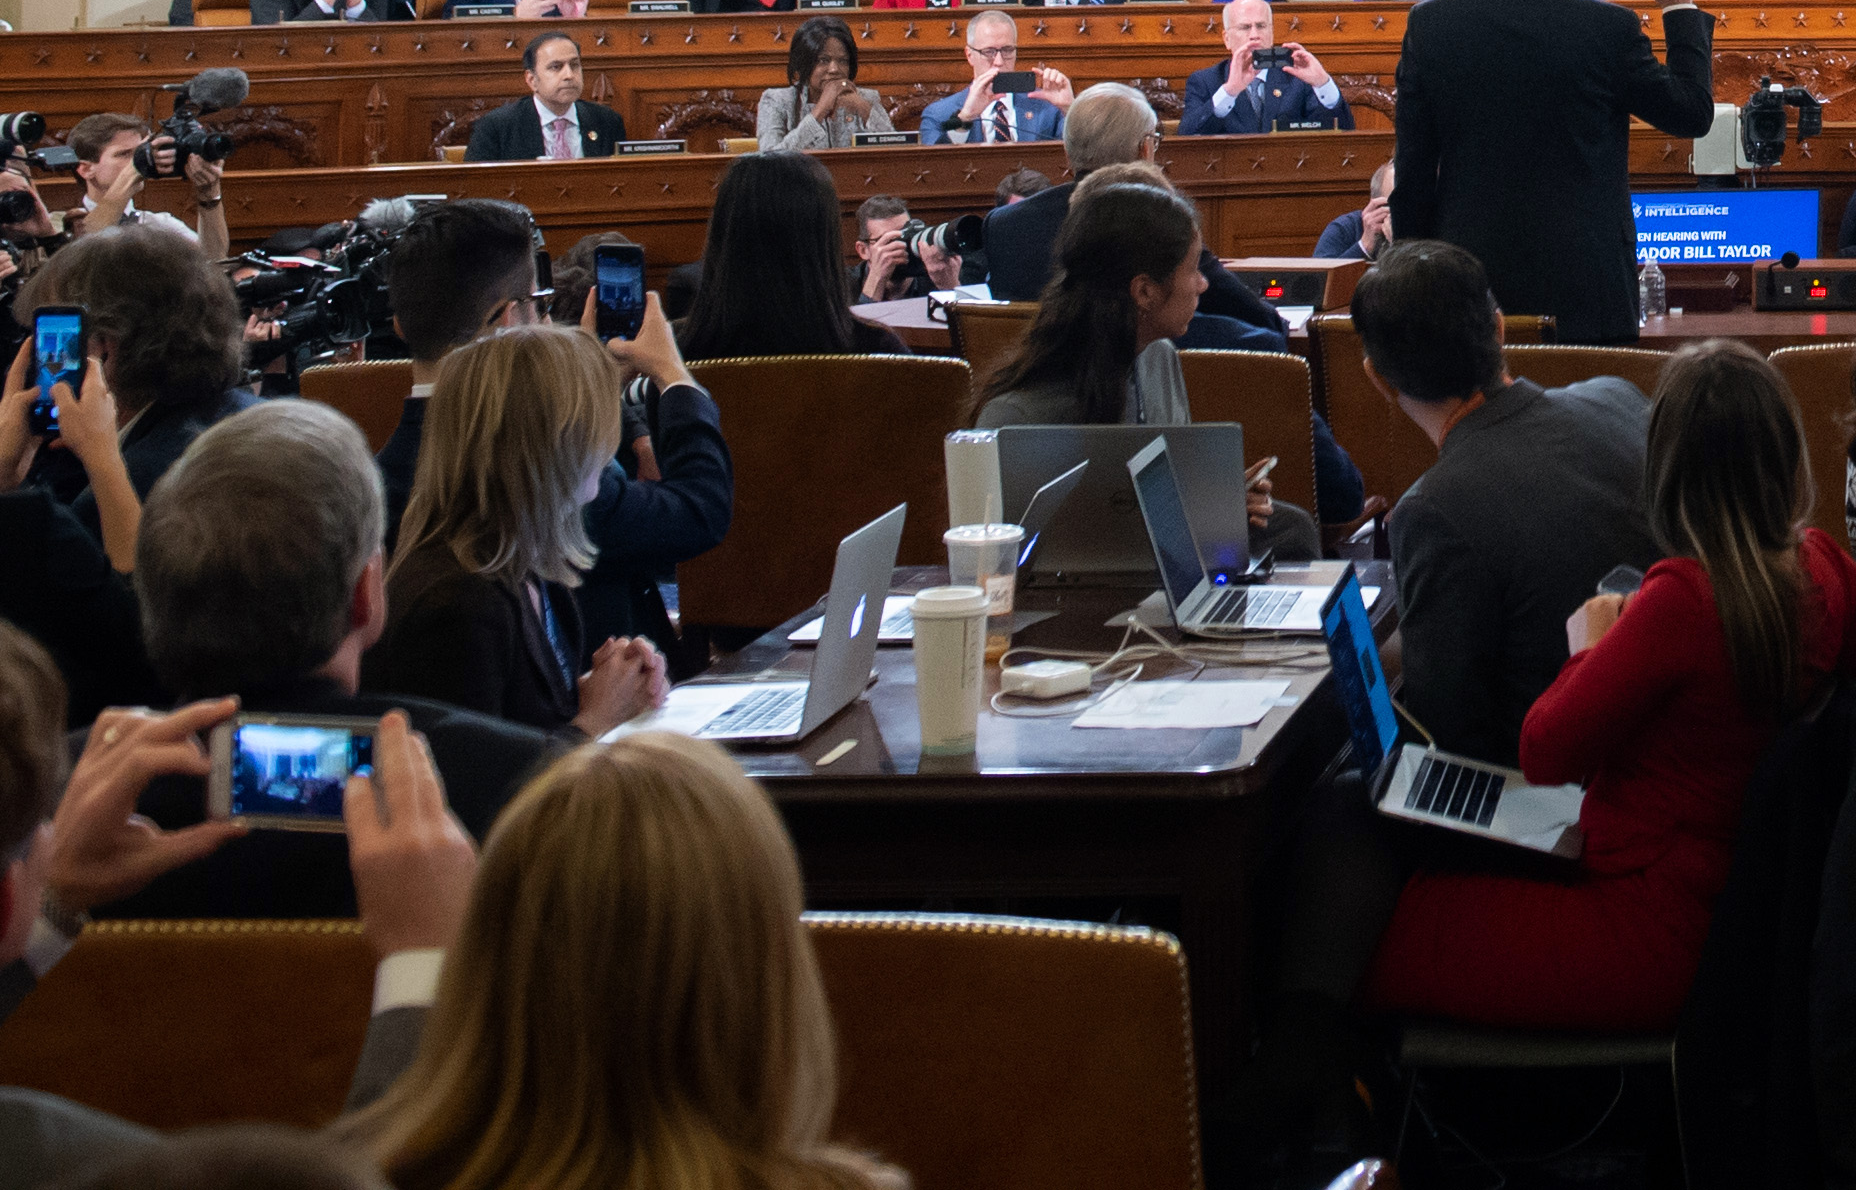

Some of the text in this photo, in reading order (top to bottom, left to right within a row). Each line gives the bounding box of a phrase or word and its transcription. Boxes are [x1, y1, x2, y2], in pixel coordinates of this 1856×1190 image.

[1645, 206, 1729, 217] INTELLIGENCE
[1653, 231, 1700, 242] HEARING
[1700, 230, 1727, 241] WITH
[1684, 245, 1716, 259] BILL
[1717, 244, 1772, 258] TAYLOR
